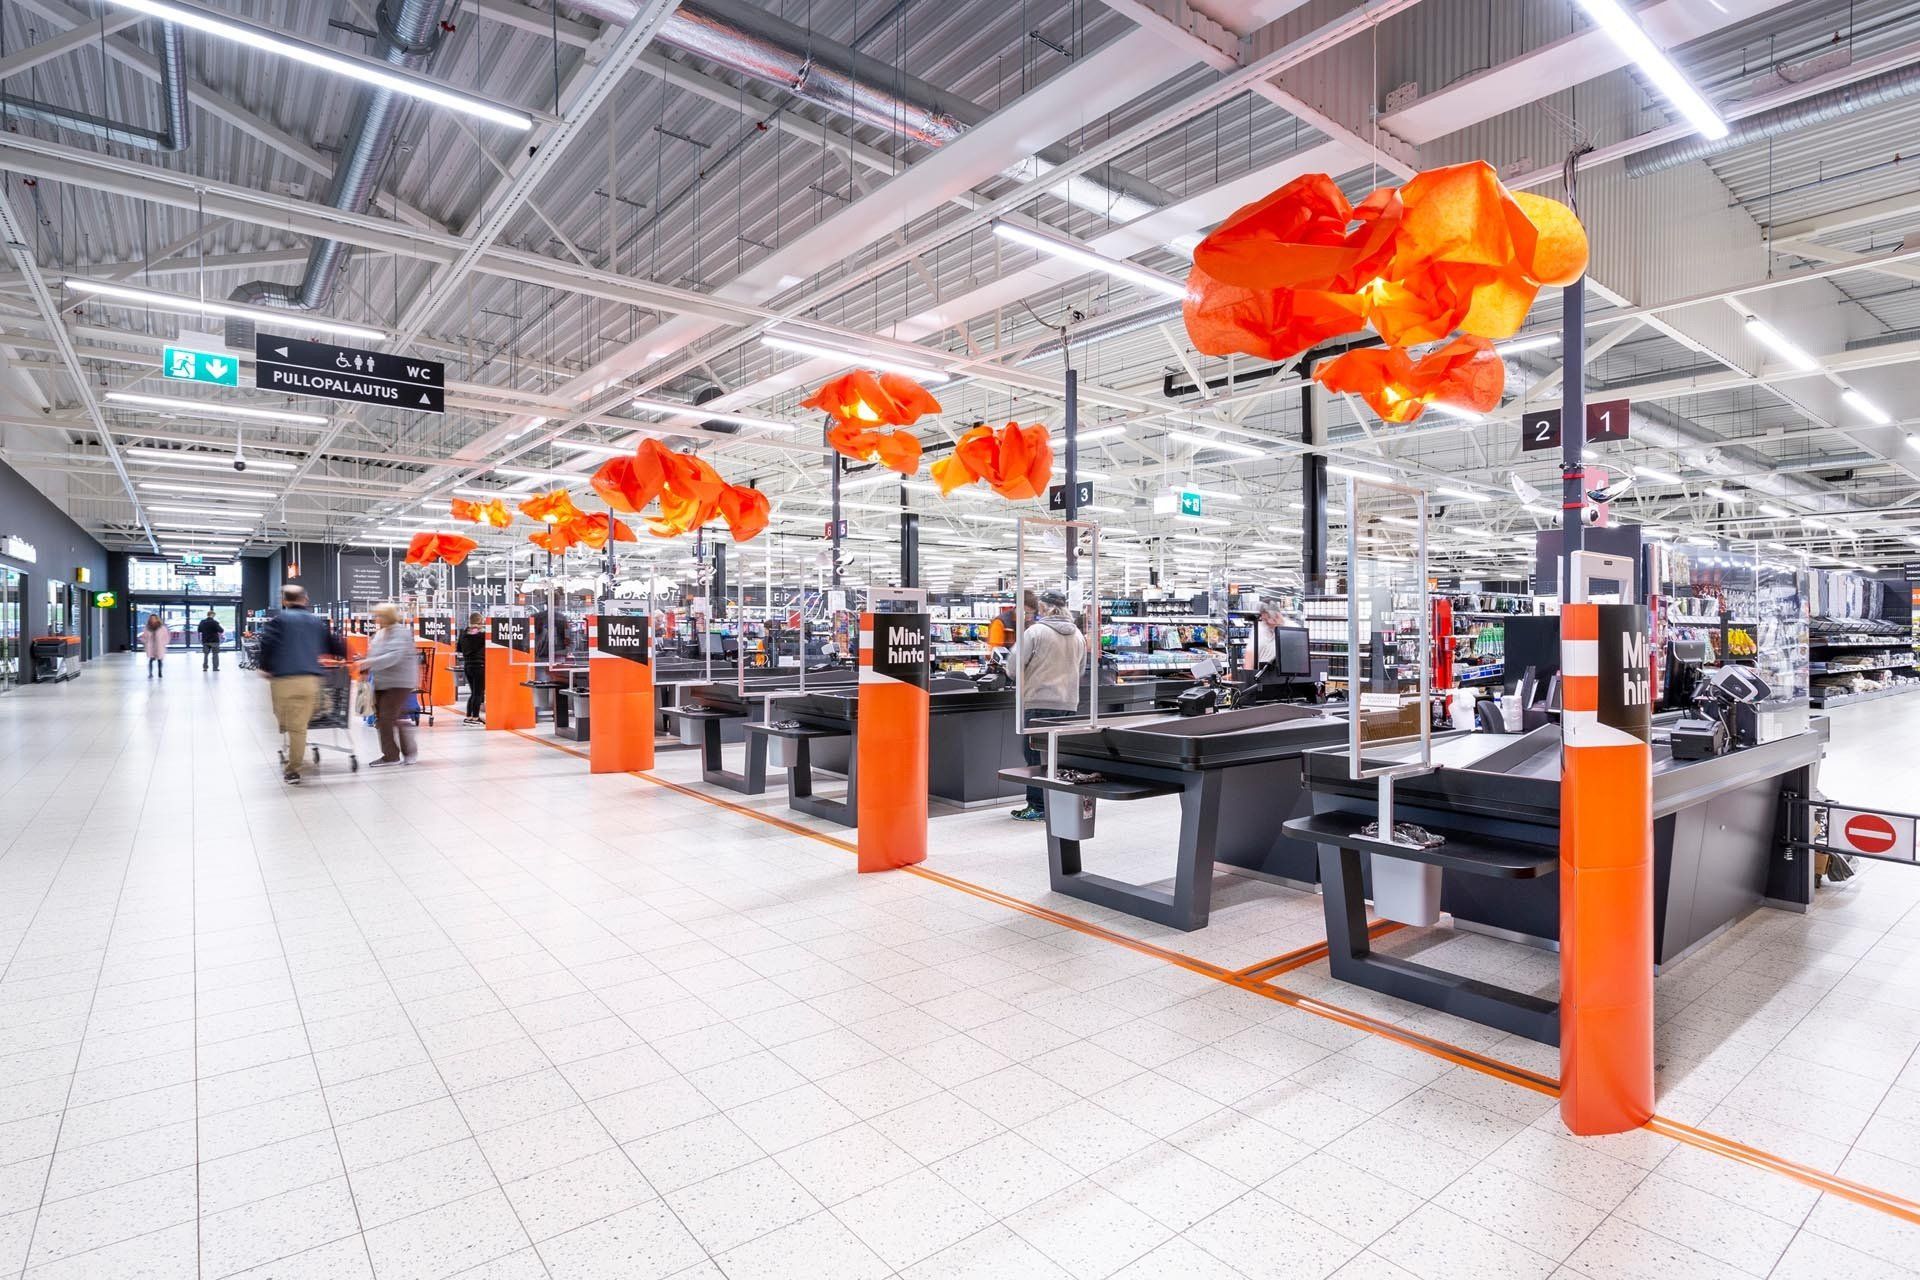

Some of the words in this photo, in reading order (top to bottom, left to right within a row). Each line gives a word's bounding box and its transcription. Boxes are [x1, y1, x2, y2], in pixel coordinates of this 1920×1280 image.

[406, 365, 431, 380] WC
[273, 370, 399, 399] PULLOPALAUTUS
[1600, 411, 1610, 432] 1
[1535, 420, 1550, 442] 2
[1054, 491, 1062, 505] 4
[1080, 487, 1089, 502] 3
[498, 622, 524, 632] Mni-
[608, 623, 640, 636] Mini-
[608, 635, 640, 647] hinta
[888, 626, 925, 646] Mini-
[888, 646, 925, 664] hinta
